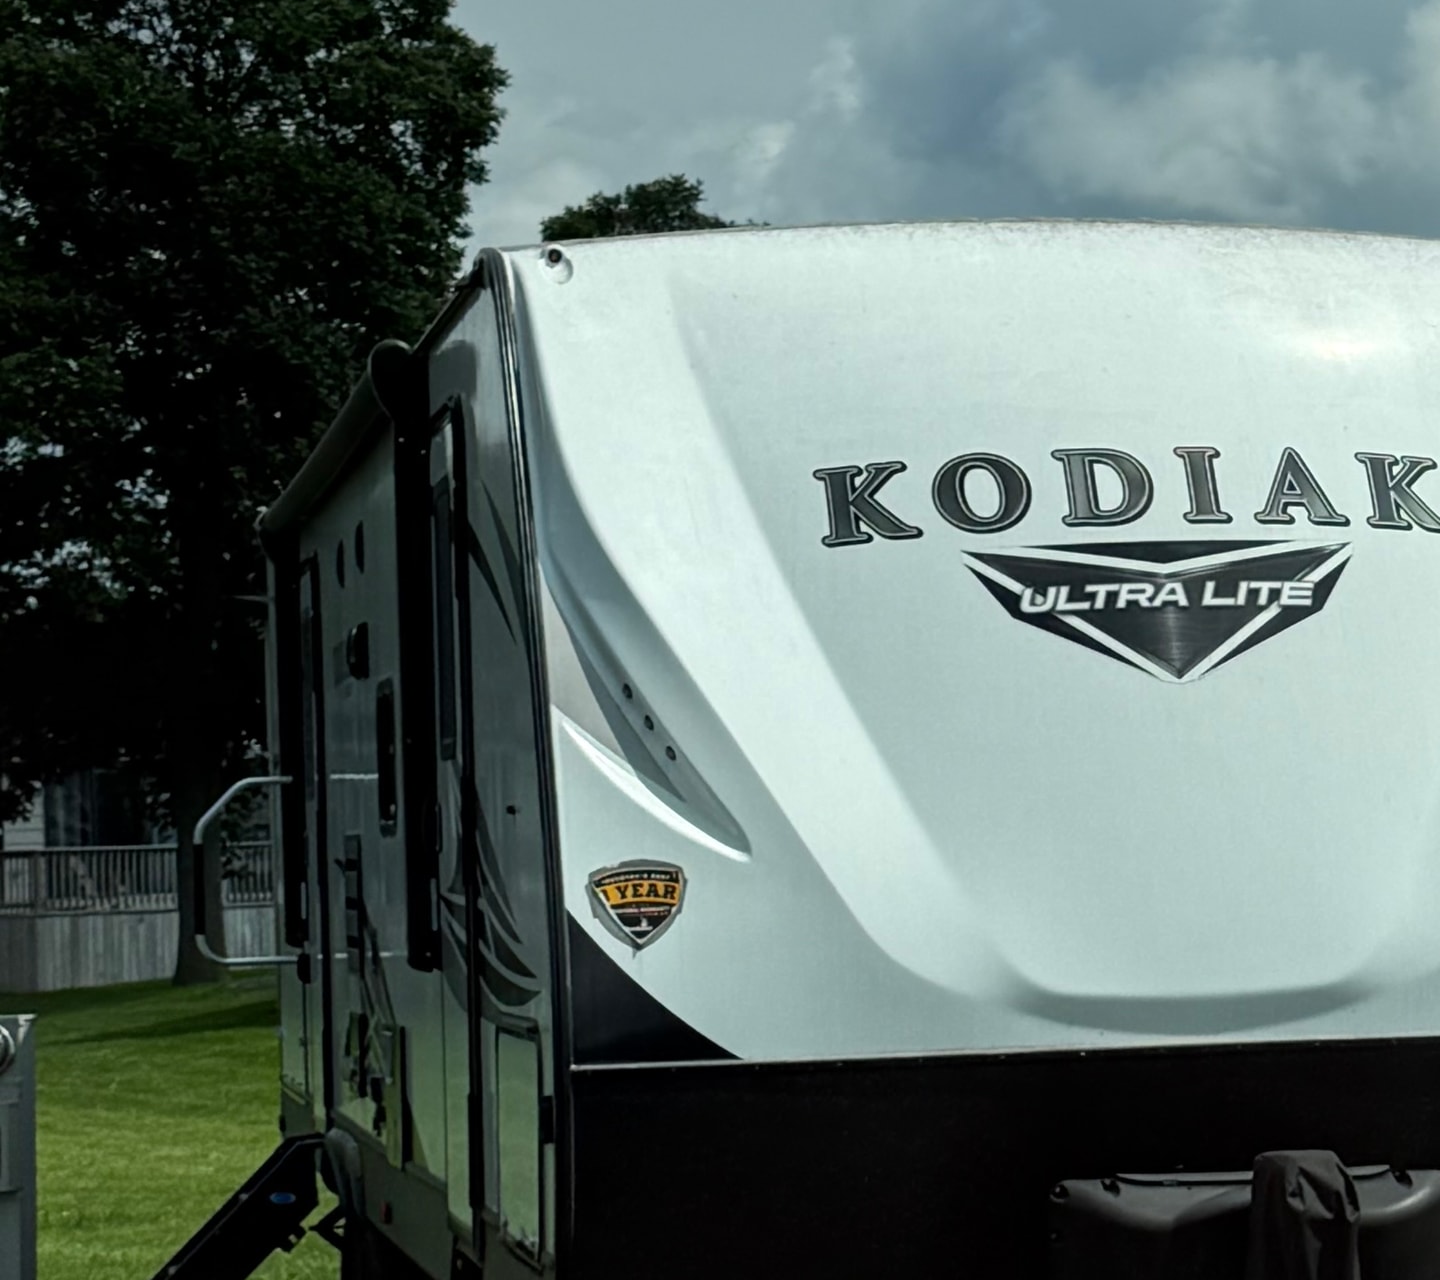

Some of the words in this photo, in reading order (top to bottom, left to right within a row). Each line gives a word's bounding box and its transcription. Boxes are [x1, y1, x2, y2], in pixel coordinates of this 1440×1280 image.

[1020, 581, 1190, 613] ULTRA
[1201, 579, 1315, 607] LITE
[615, 882, 677, 901] YEAR
